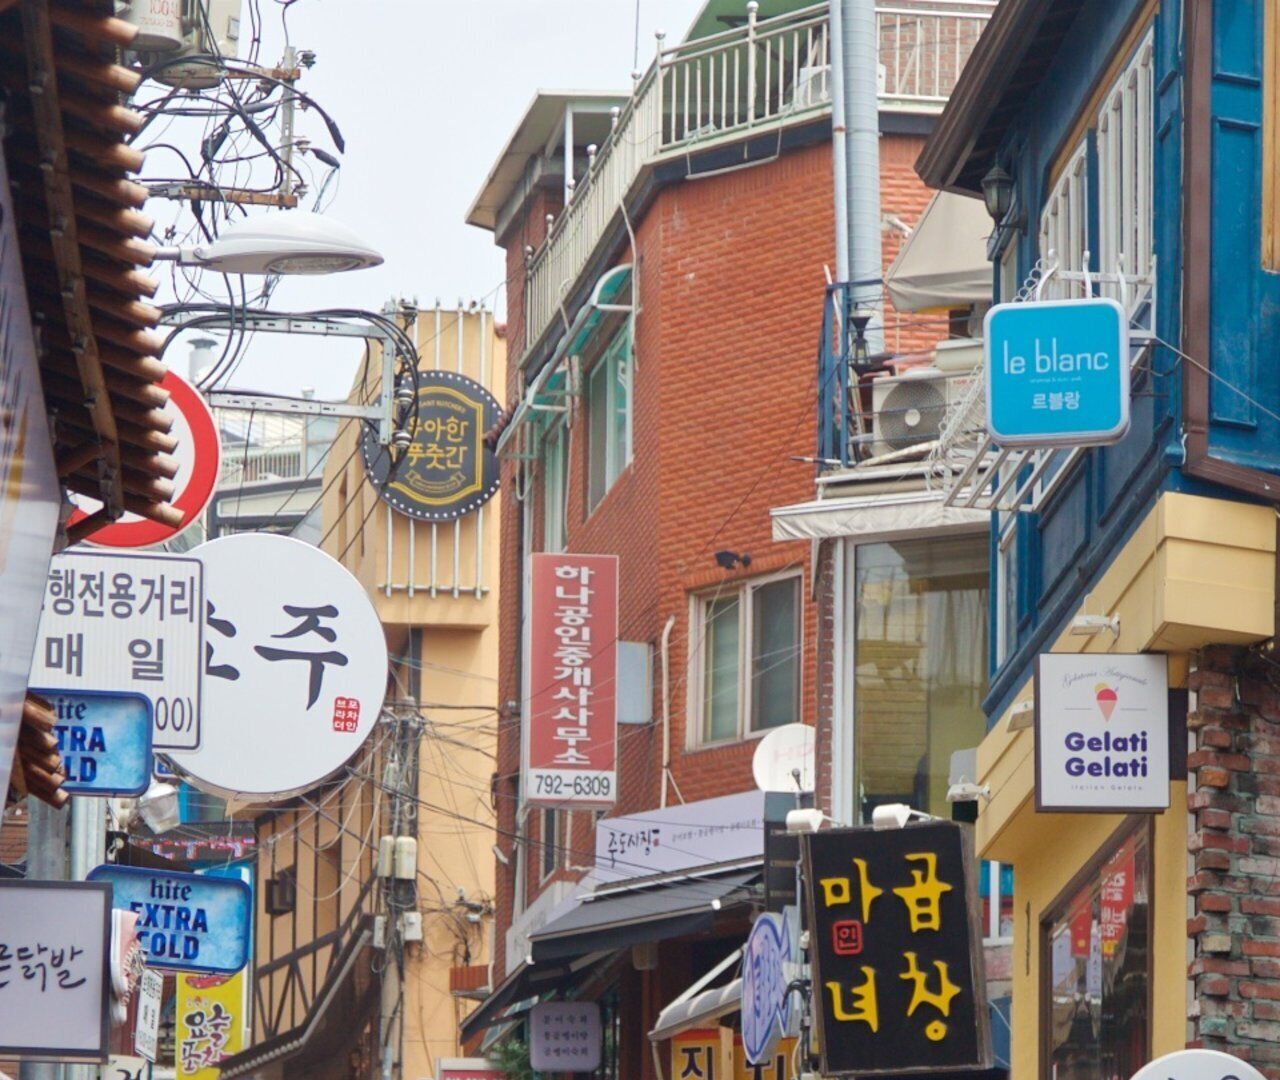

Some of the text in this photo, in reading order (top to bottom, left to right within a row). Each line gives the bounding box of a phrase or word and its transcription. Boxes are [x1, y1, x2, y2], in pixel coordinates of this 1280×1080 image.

[1003, 338, 1109, 374] le blanc
[1031, 392, 1080, 412] 르블랑
[43, 569, 194, 623] 행전용거리
[552, 566, 595, 765] 하나공인중개사사무소
[51, 697, 87, 721] ite
[155, 696, 193, 733] 00)
[54, 725, 106, 752] TRA
[1065, 731, 1147, 752] Gelati
[65, 757, 97, 782] LD
[1065, 756, 1147, 777] Gelati
[535, 775, 611, 796] 792-6309
[151, 878, 192, 901] hite
[130, 902, 208, 933] EXTRA
